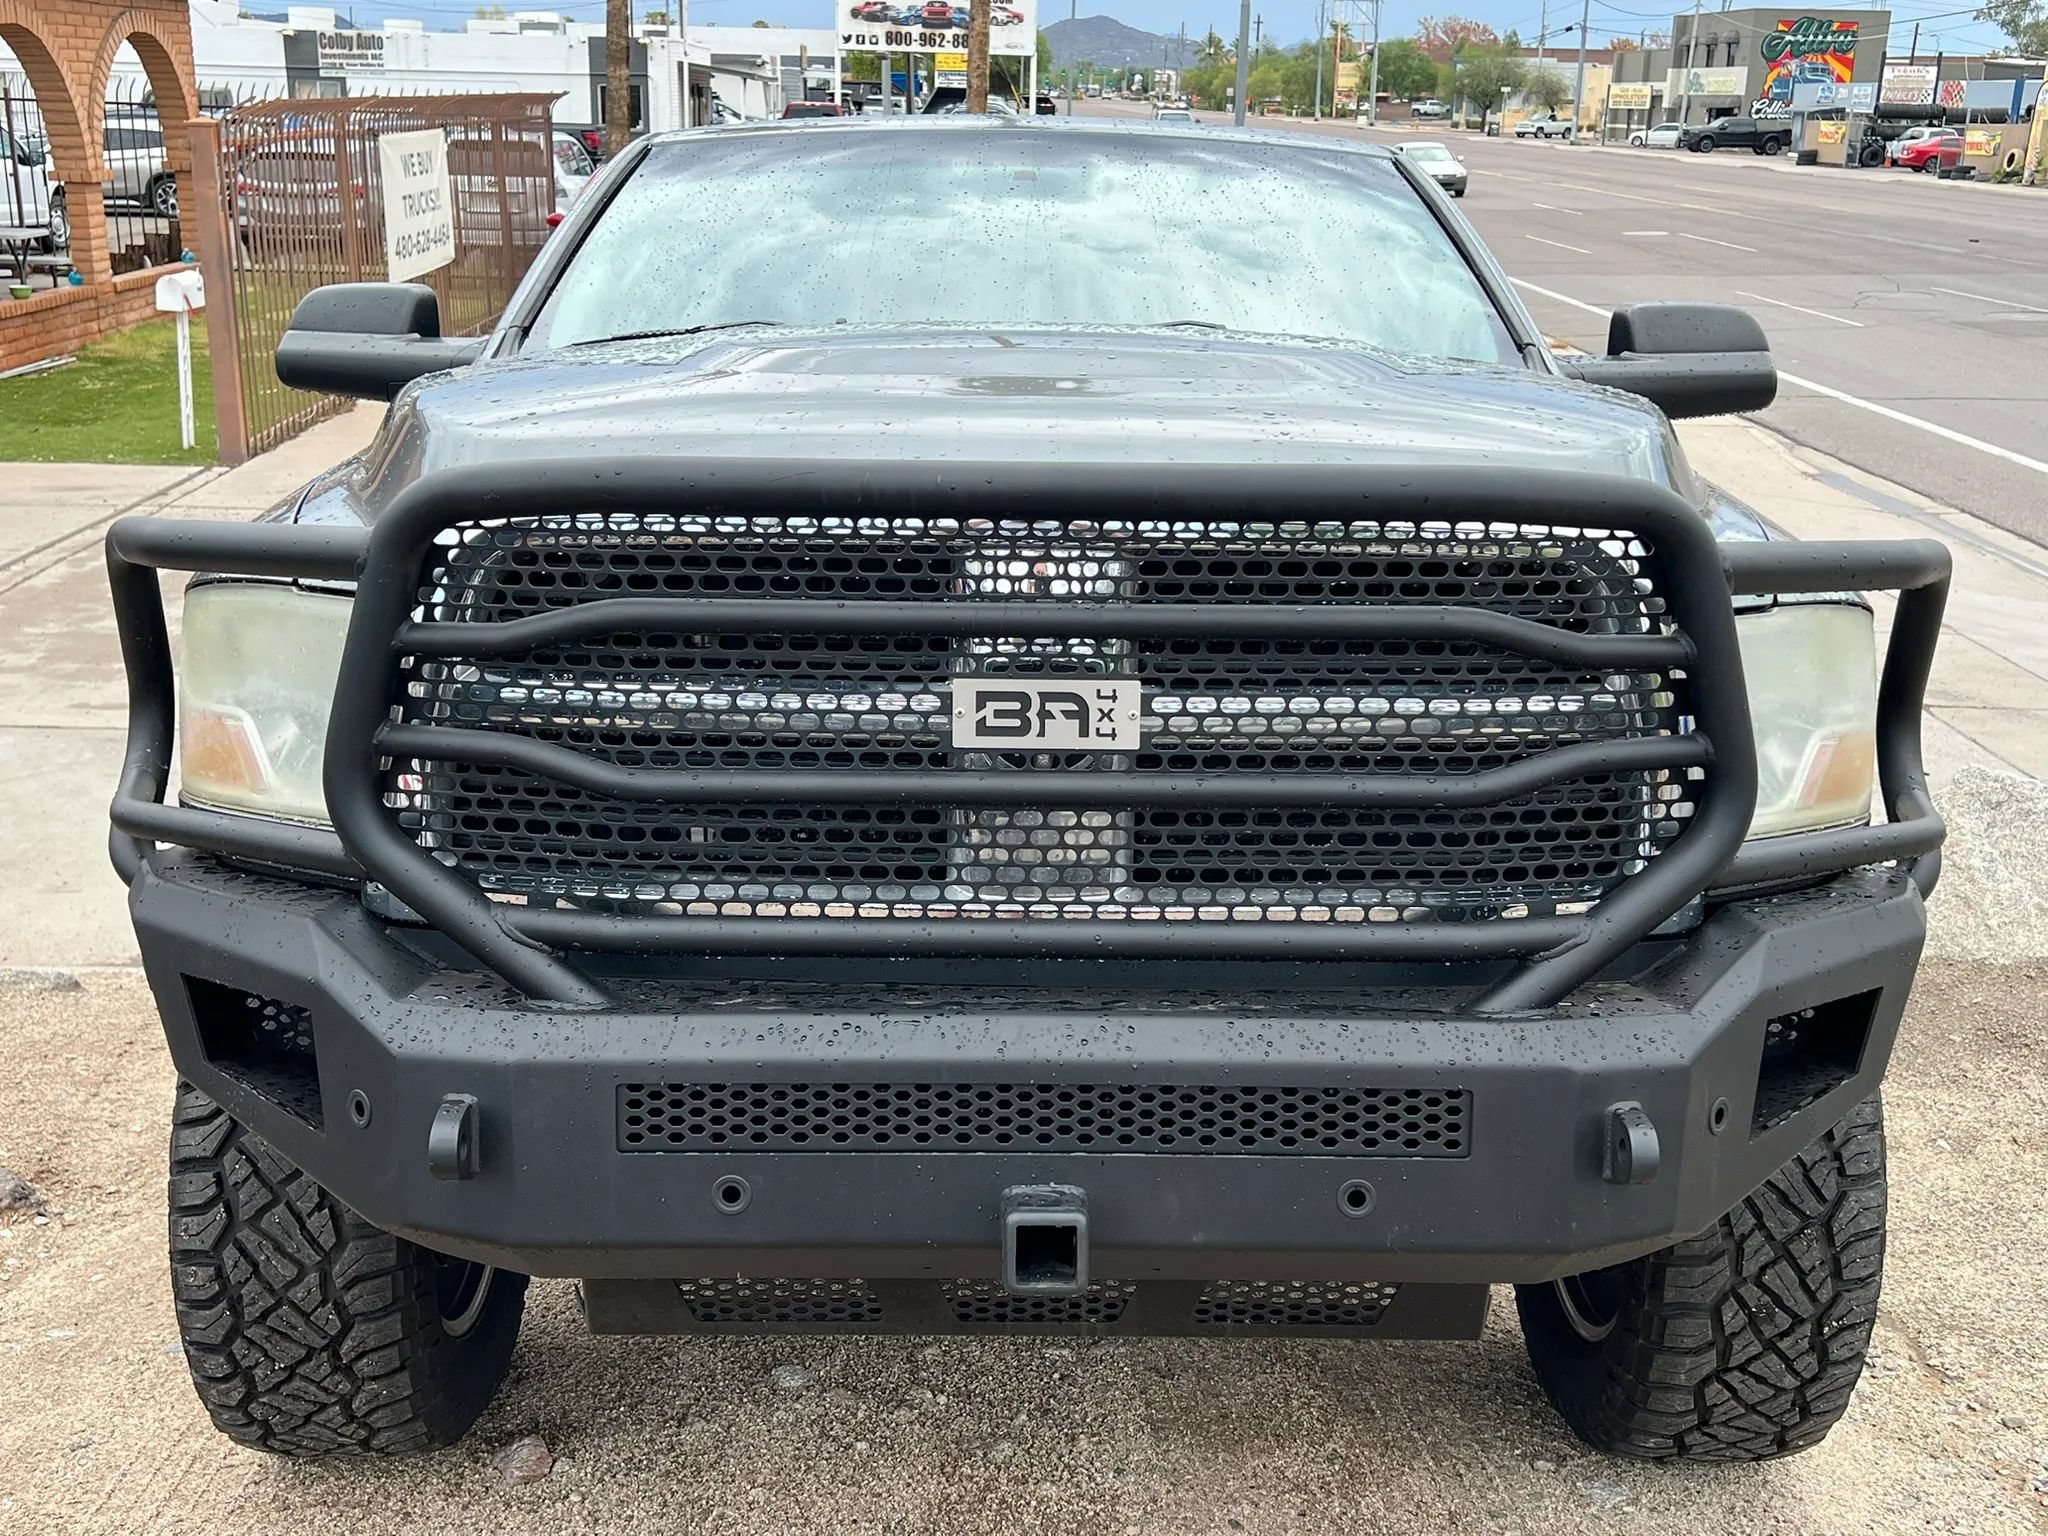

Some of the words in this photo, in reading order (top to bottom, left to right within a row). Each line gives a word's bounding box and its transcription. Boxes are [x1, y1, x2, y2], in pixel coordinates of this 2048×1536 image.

[319, 32, 354, 51] Colby
[356, 32, 384, 50] Auto
[885, 31, 969, 49] 800-962-88
[320, 51, 369, 60] Investments
[400, 152, 417, 179] WE
[417, 150, 433, 176] BUY
